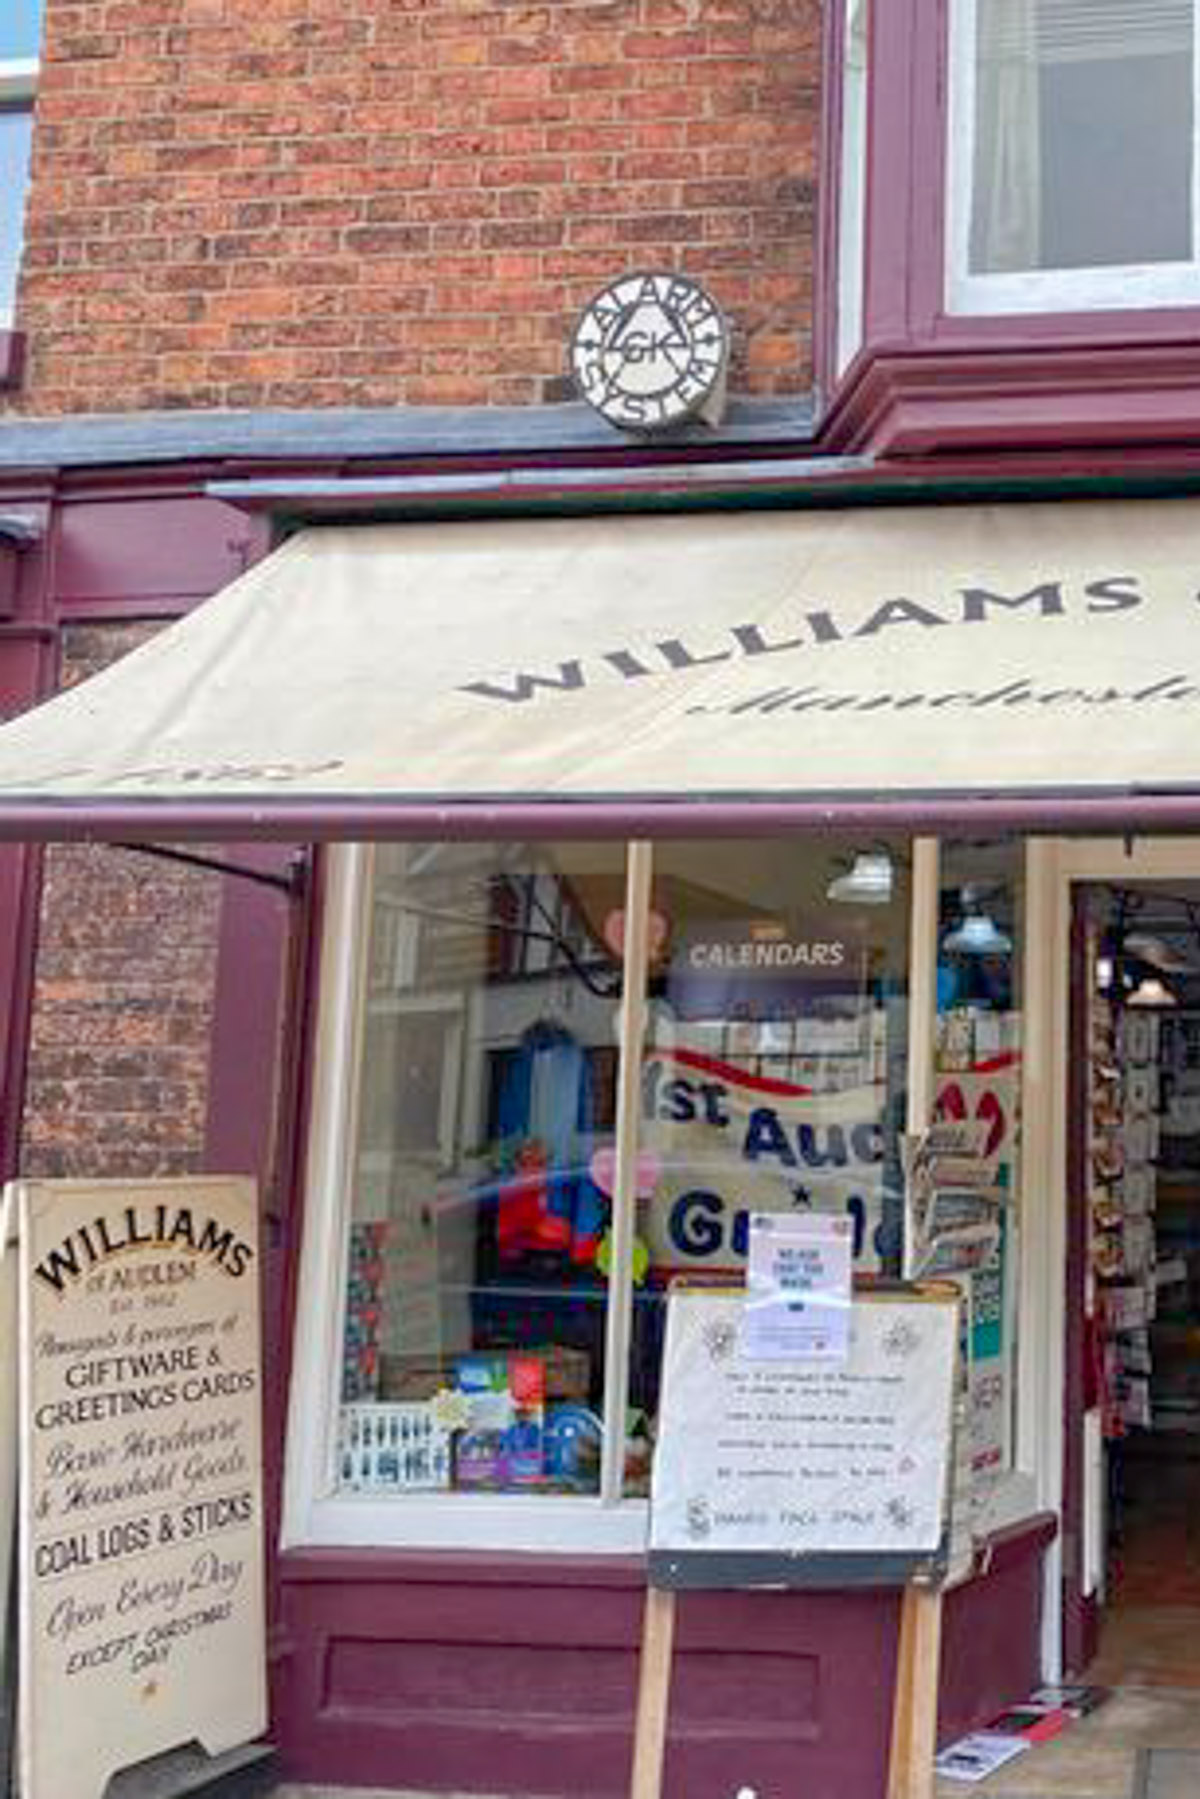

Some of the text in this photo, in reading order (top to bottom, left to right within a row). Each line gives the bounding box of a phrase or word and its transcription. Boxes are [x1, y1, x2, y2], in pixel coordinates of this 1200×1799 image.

[456, 576, 1142, 703] WILLIAMS
[689, 941, 845, 968] CALENDARS
[35, 1205, 254, 1292] WILLIAMS
[109, 1259, 198, 1292] AUDLEM
[35, 1369, 255, 1430] GREETINGS CARDS
[65, 1345, 221, 1390] GIFTWARE &
[47, 1418, 242, 1478] Basic Hardware
[61, 1460, 178, 1514] Household
[183, 1446, 247, 1498] Goods
[35, 1492, 253, 1577] COAL LOGS & STICKS
[47, 1549, 244, 1643] Open Every Day
[65, 1600, 234, 1675] EXCEPT CHRISTMAS
[131, 1643, 172, 1674] DAY
